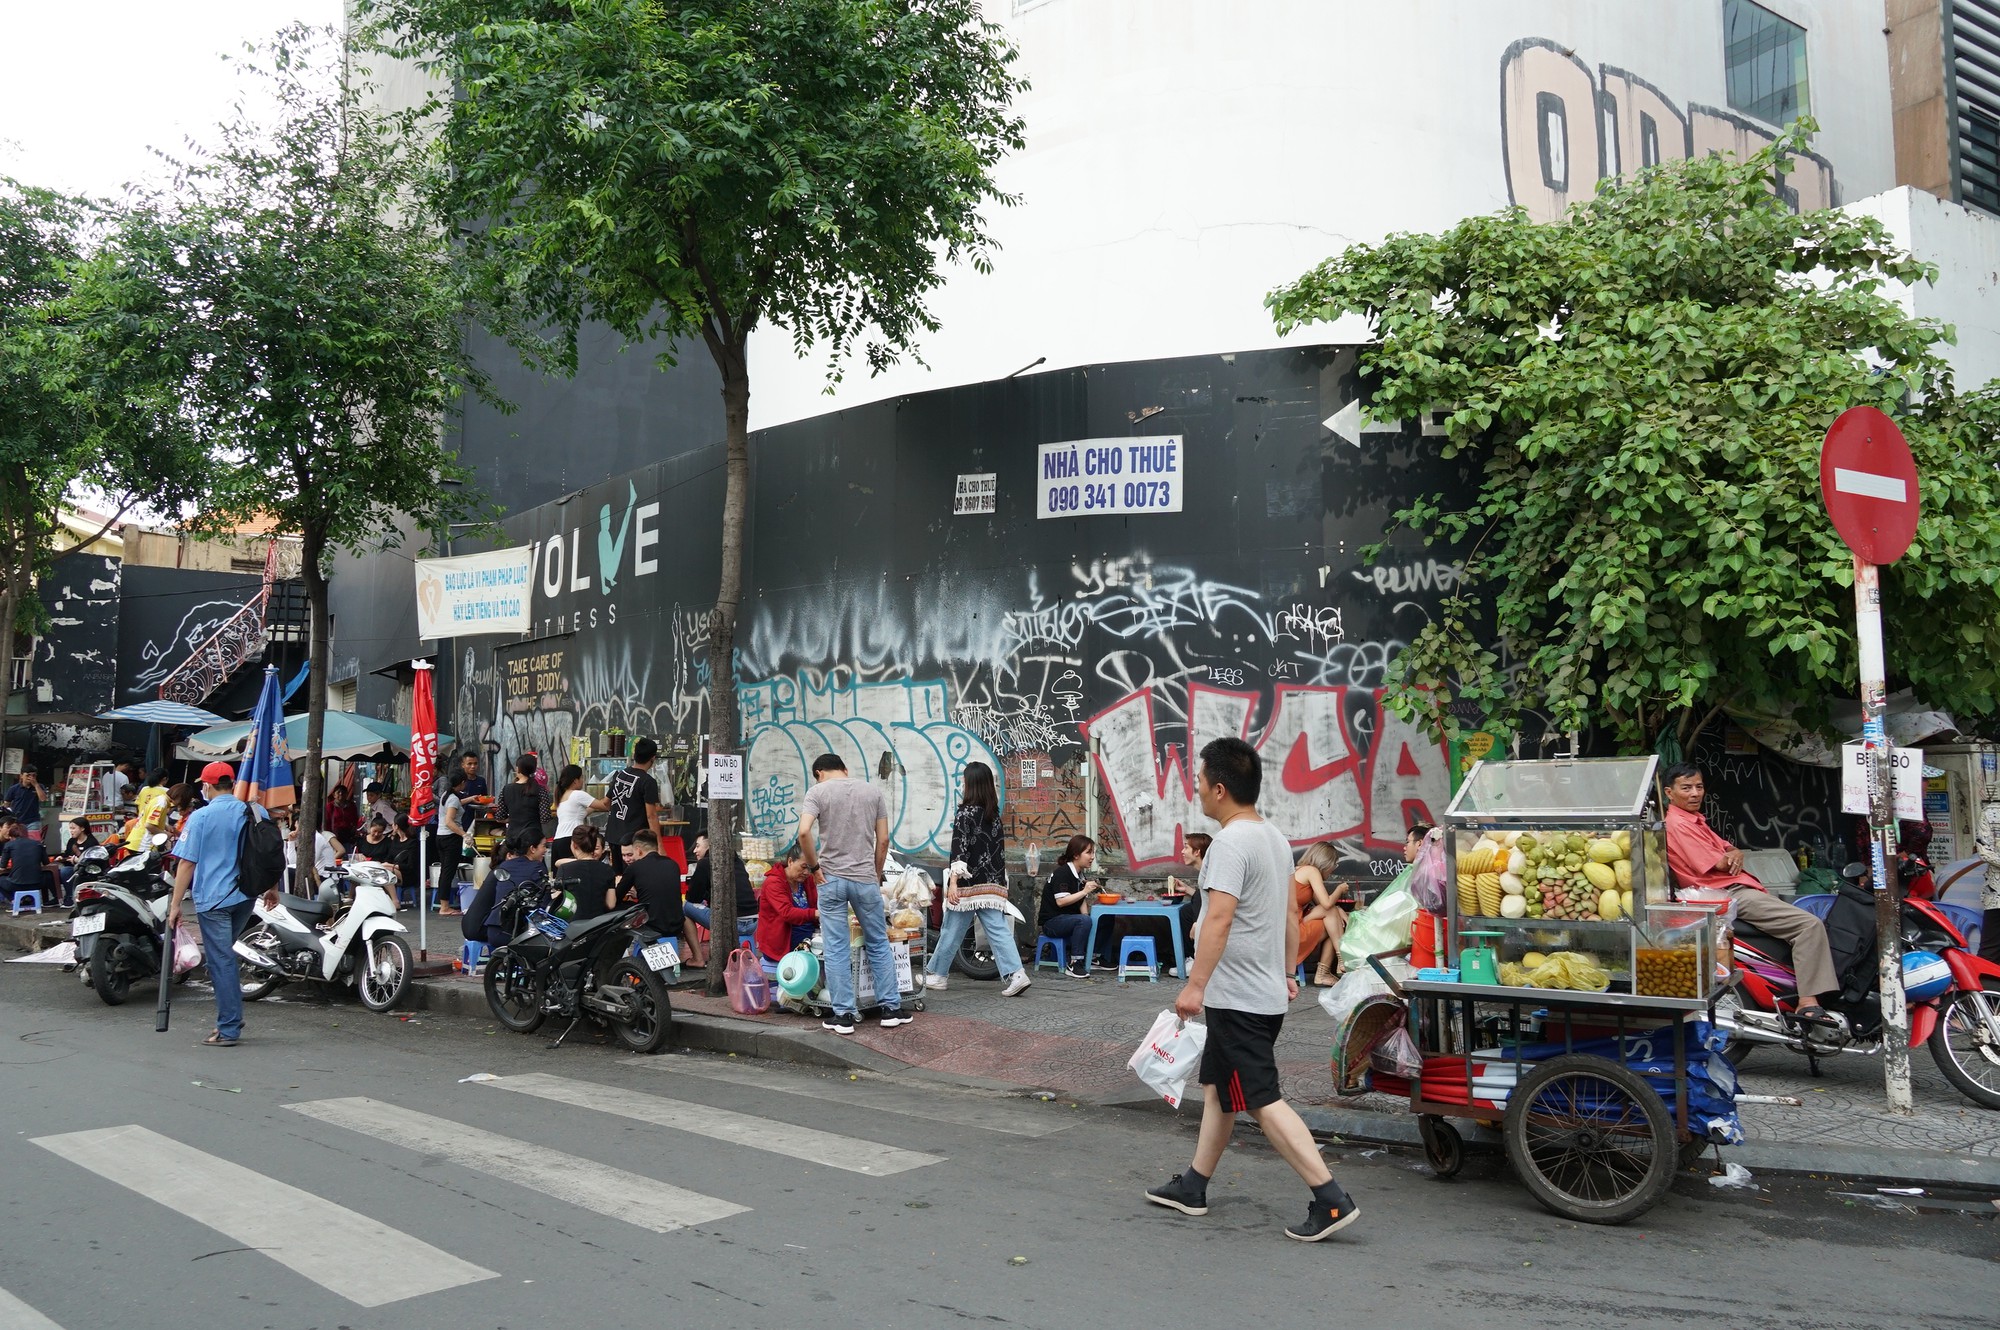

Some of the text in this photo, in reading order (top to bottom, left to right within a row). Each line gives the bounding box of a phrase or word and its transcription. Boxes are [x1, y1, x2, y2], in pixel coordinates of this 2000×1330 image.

[1044, 439, 1177, 479] NHÀ CHO THUÊ
[968, 480, 980, 493] CHO
[1048, 481, 1170, 513] 090 341 0073
[521, 603, 616, 642] ITNESS
[507, 651, 564, 676] TAKE CARE OF
[507, 675, 529, 697] YOUR
[536, 672, 563, 693] BODY.
[1022, 760, 1035, 769] BNE
[1890, 751, 1910, 769] BÒ
